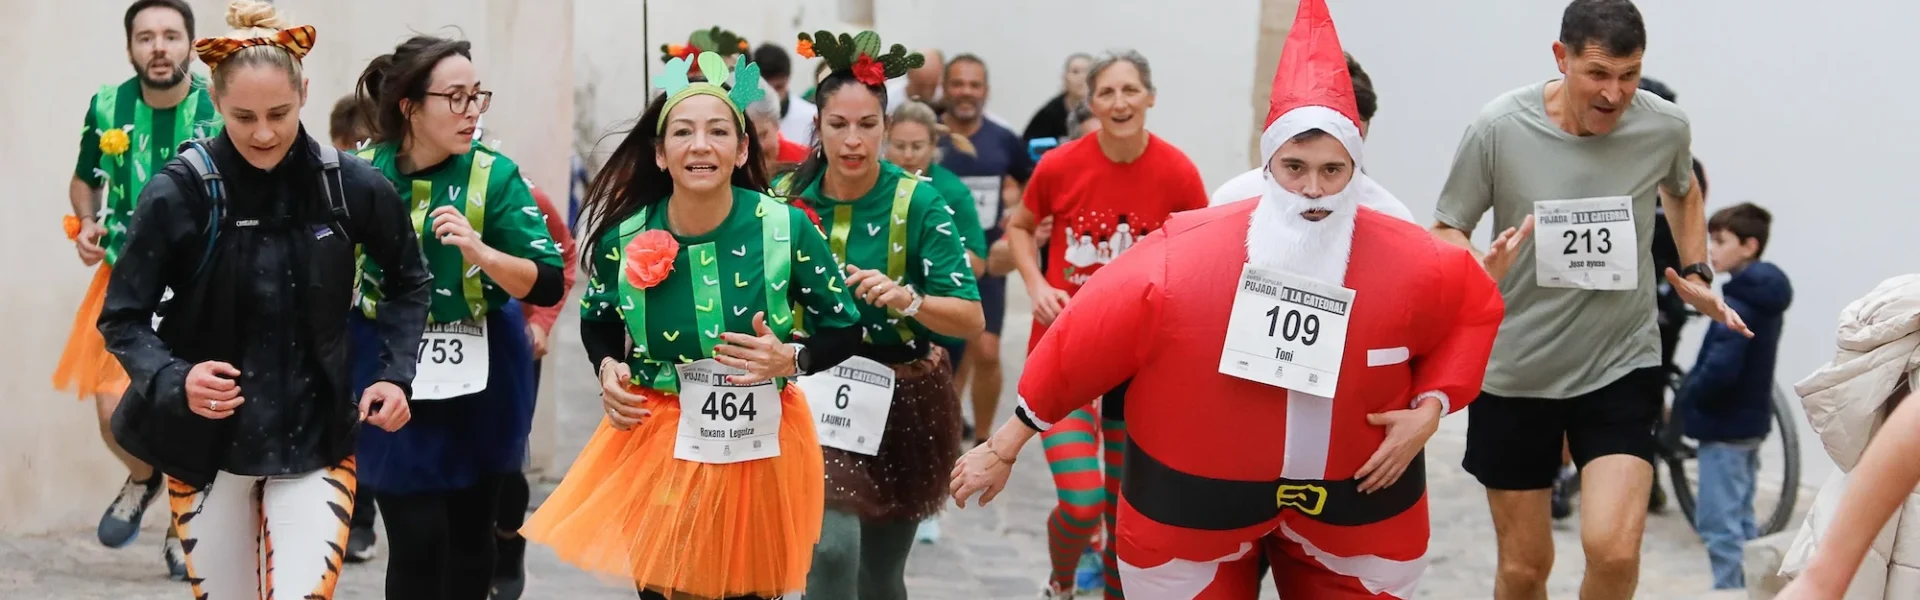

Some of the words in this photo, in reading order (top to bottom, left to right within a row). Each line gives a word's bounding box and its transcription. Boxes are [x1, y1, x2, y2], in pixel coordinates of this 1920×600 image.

[1540, 215, 1568, 224] PUJADA
[1572, 212, 1578, 224] A
[1580, 212, 1590, 223] LA
[1591, 210, 1629, 222] CATEDRAL
[1563, 227, 1612, 255] 213
[1244, 280, 1277, 297] PUJADA
[1281, 287, 1288, 300] A
[1290, 289, 1301, 303] LA
[1303, 292, 1345, 315] CATEDRAL
[1266, 305, 1320, 346] 109
[417, 338, 464, 365] 753
[1275, 347, 1294, 362] Toni
[683, 371, 709, 384] PUJADA
[841, 367, 851, 378] LA
[852, 369, 889, 388] CATEDRAL
[701, 391, 757, 421] 464
[835, 384, 851, 410] 6
[821, 413, 851, 428] LAURITA
[700, 427, 725, 438] Roxana
